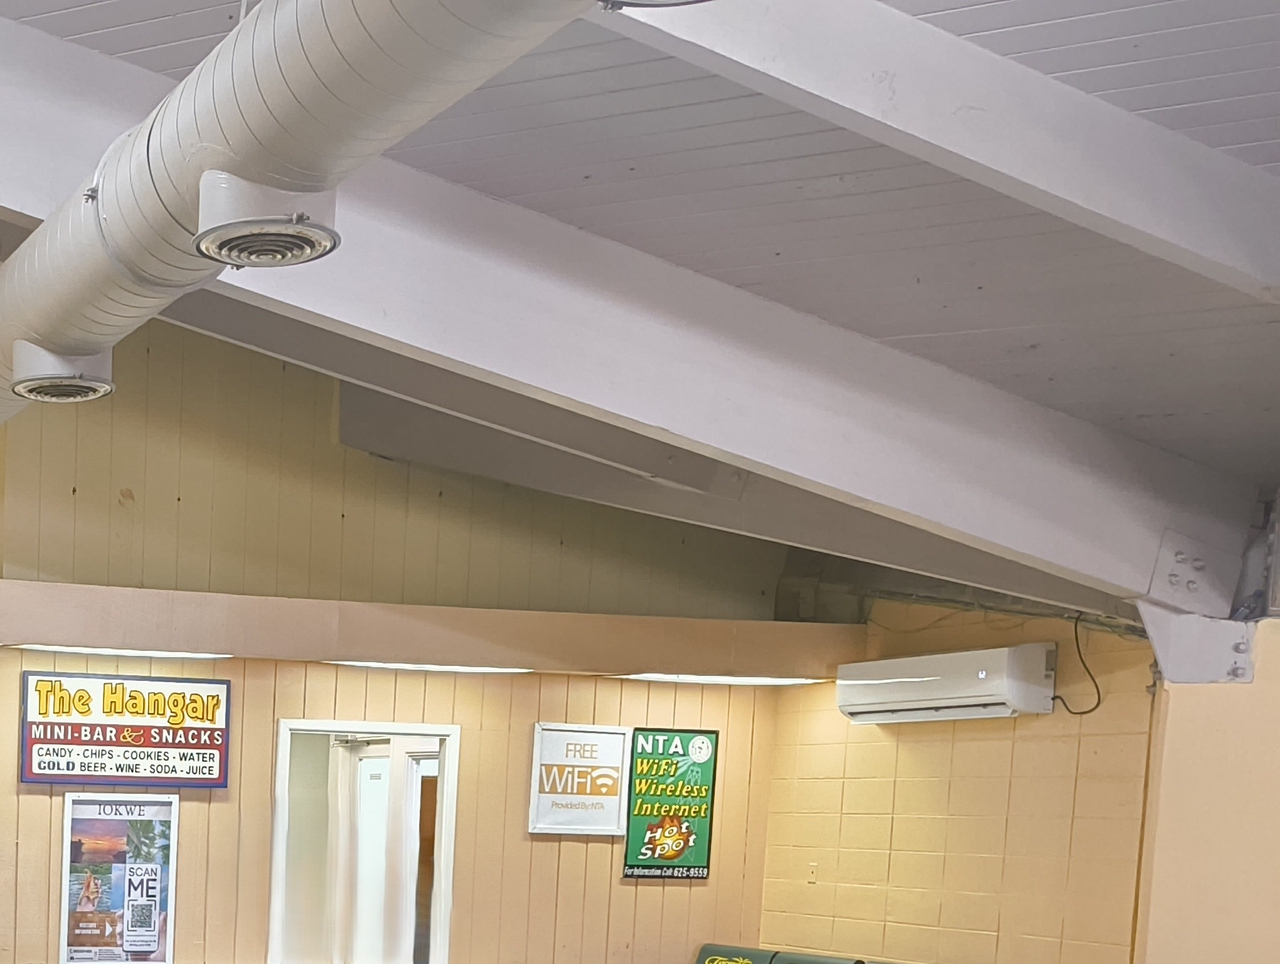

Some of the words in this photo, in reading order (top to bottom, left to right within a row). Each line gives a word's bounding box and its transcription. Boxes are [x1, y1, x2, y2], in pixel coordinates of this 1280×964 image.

[35, 680, 92, 717] The
[103, 682, 221, 726] Hangar
[31, 724, 117, 741] MINI-BAR
[120, 727, 144, 745] &
[150, 728, 223, 745] SNACKS
[565, 743, 598, 760] FREE
[636, 735, 684, 755] NTA
[37, 747, 74, 758] CANDY
[82, 749, 114, 759] CHIPS
[122, 750, 170, 761] COOKIES
[178, 752, 216, 763] WATER
[37, 760, 75, 771] COLD
[79, 761, 107, 772] BEER
[115, 763, 141, 773] WINE
[149, 764, 178, 774] SODA
[185, 765, 215, 776] JUICE
[635, 758, 678, 776] WiFi
[541, 766, 592, 794] WiFi
[634, 779, 708, 798] Wireless
[97, 803, 146, 817] IOKWE
[551, 801, 580, 810] Provided
[633, 799, 708, 817] Internet
[644, 822, 690, 843] Hot
[637, 834, 697, 860] Spot
[128, 867, 158, 877] SCAN
[634, 866, 661, 876] Information
[673, 867, 708, 878] 625-9559
[127, 878, 157, 898] ME
